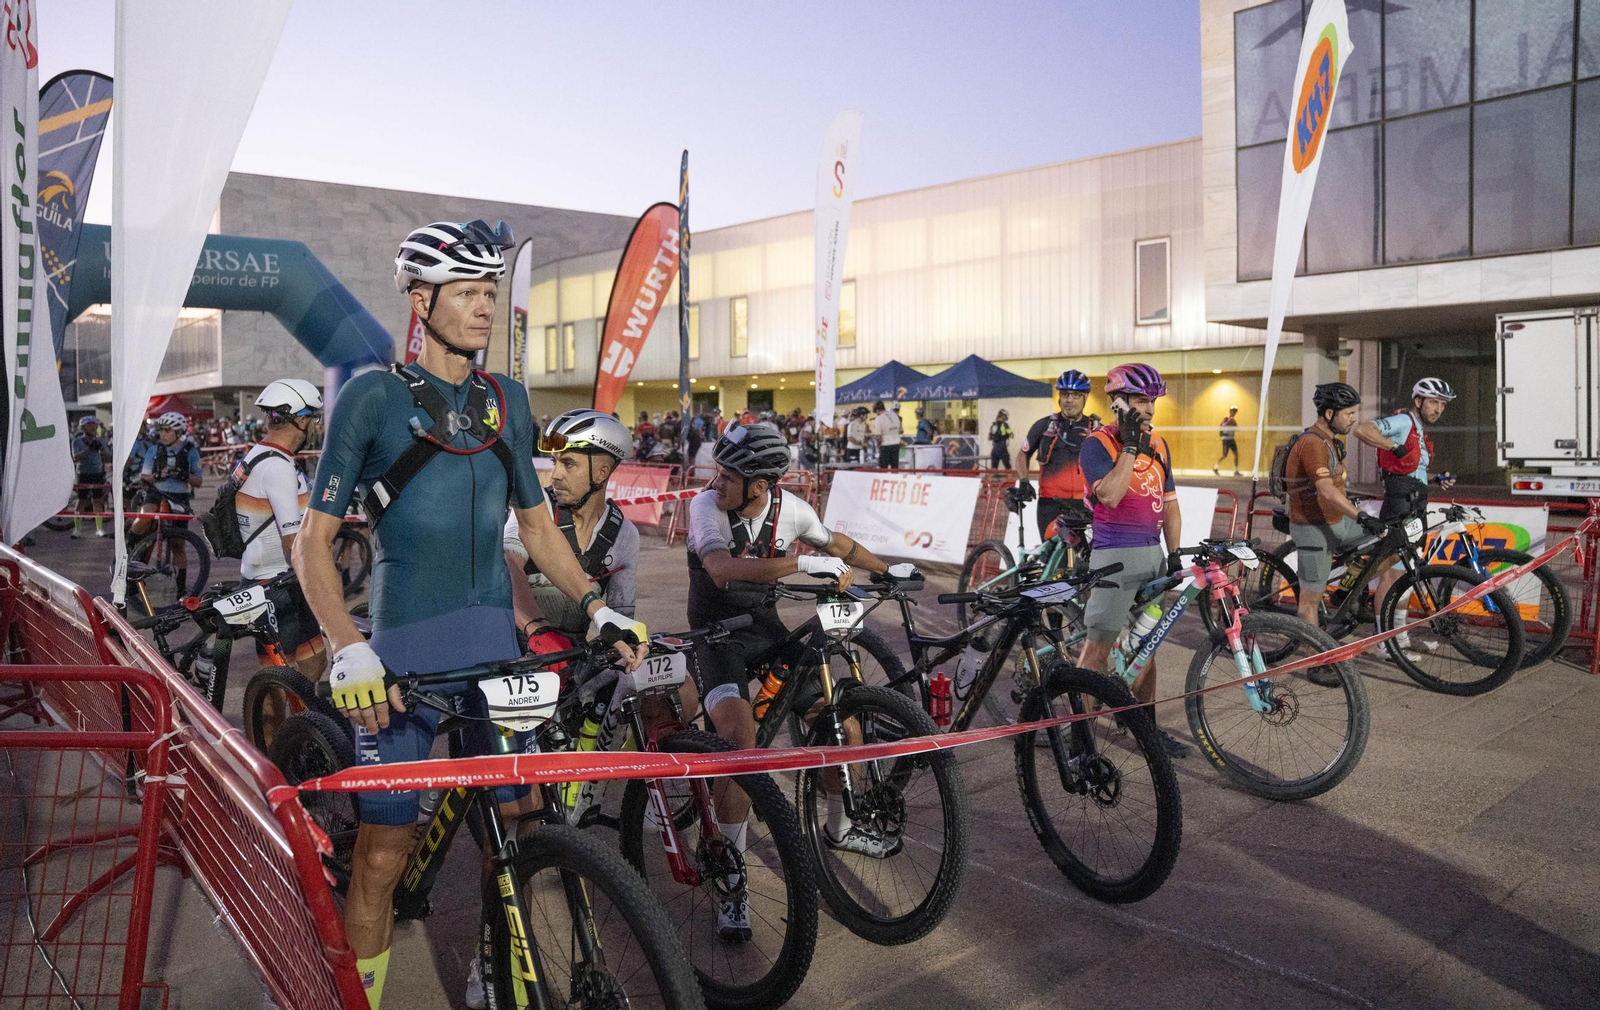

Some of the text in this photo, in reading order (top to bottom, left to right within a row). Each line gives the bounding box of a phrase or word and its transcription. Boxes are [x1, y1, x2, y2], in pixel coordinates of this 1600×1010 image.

[238, 274, 256, 288] de
[261, 277, 280, 289] FP
[622, 227, 680, 339] WÜRTH
[589, 433, 627, 458] S-WORKS
[226, 591, 253, 607] 189
[830, 604, 851, 618] 173
[1137, 595, 1188, 661] lucca&love
[647, 656, 673, 676] 172
[502, 675, 540, 696] 175
[508, 695, 540, 706] ANDREW
